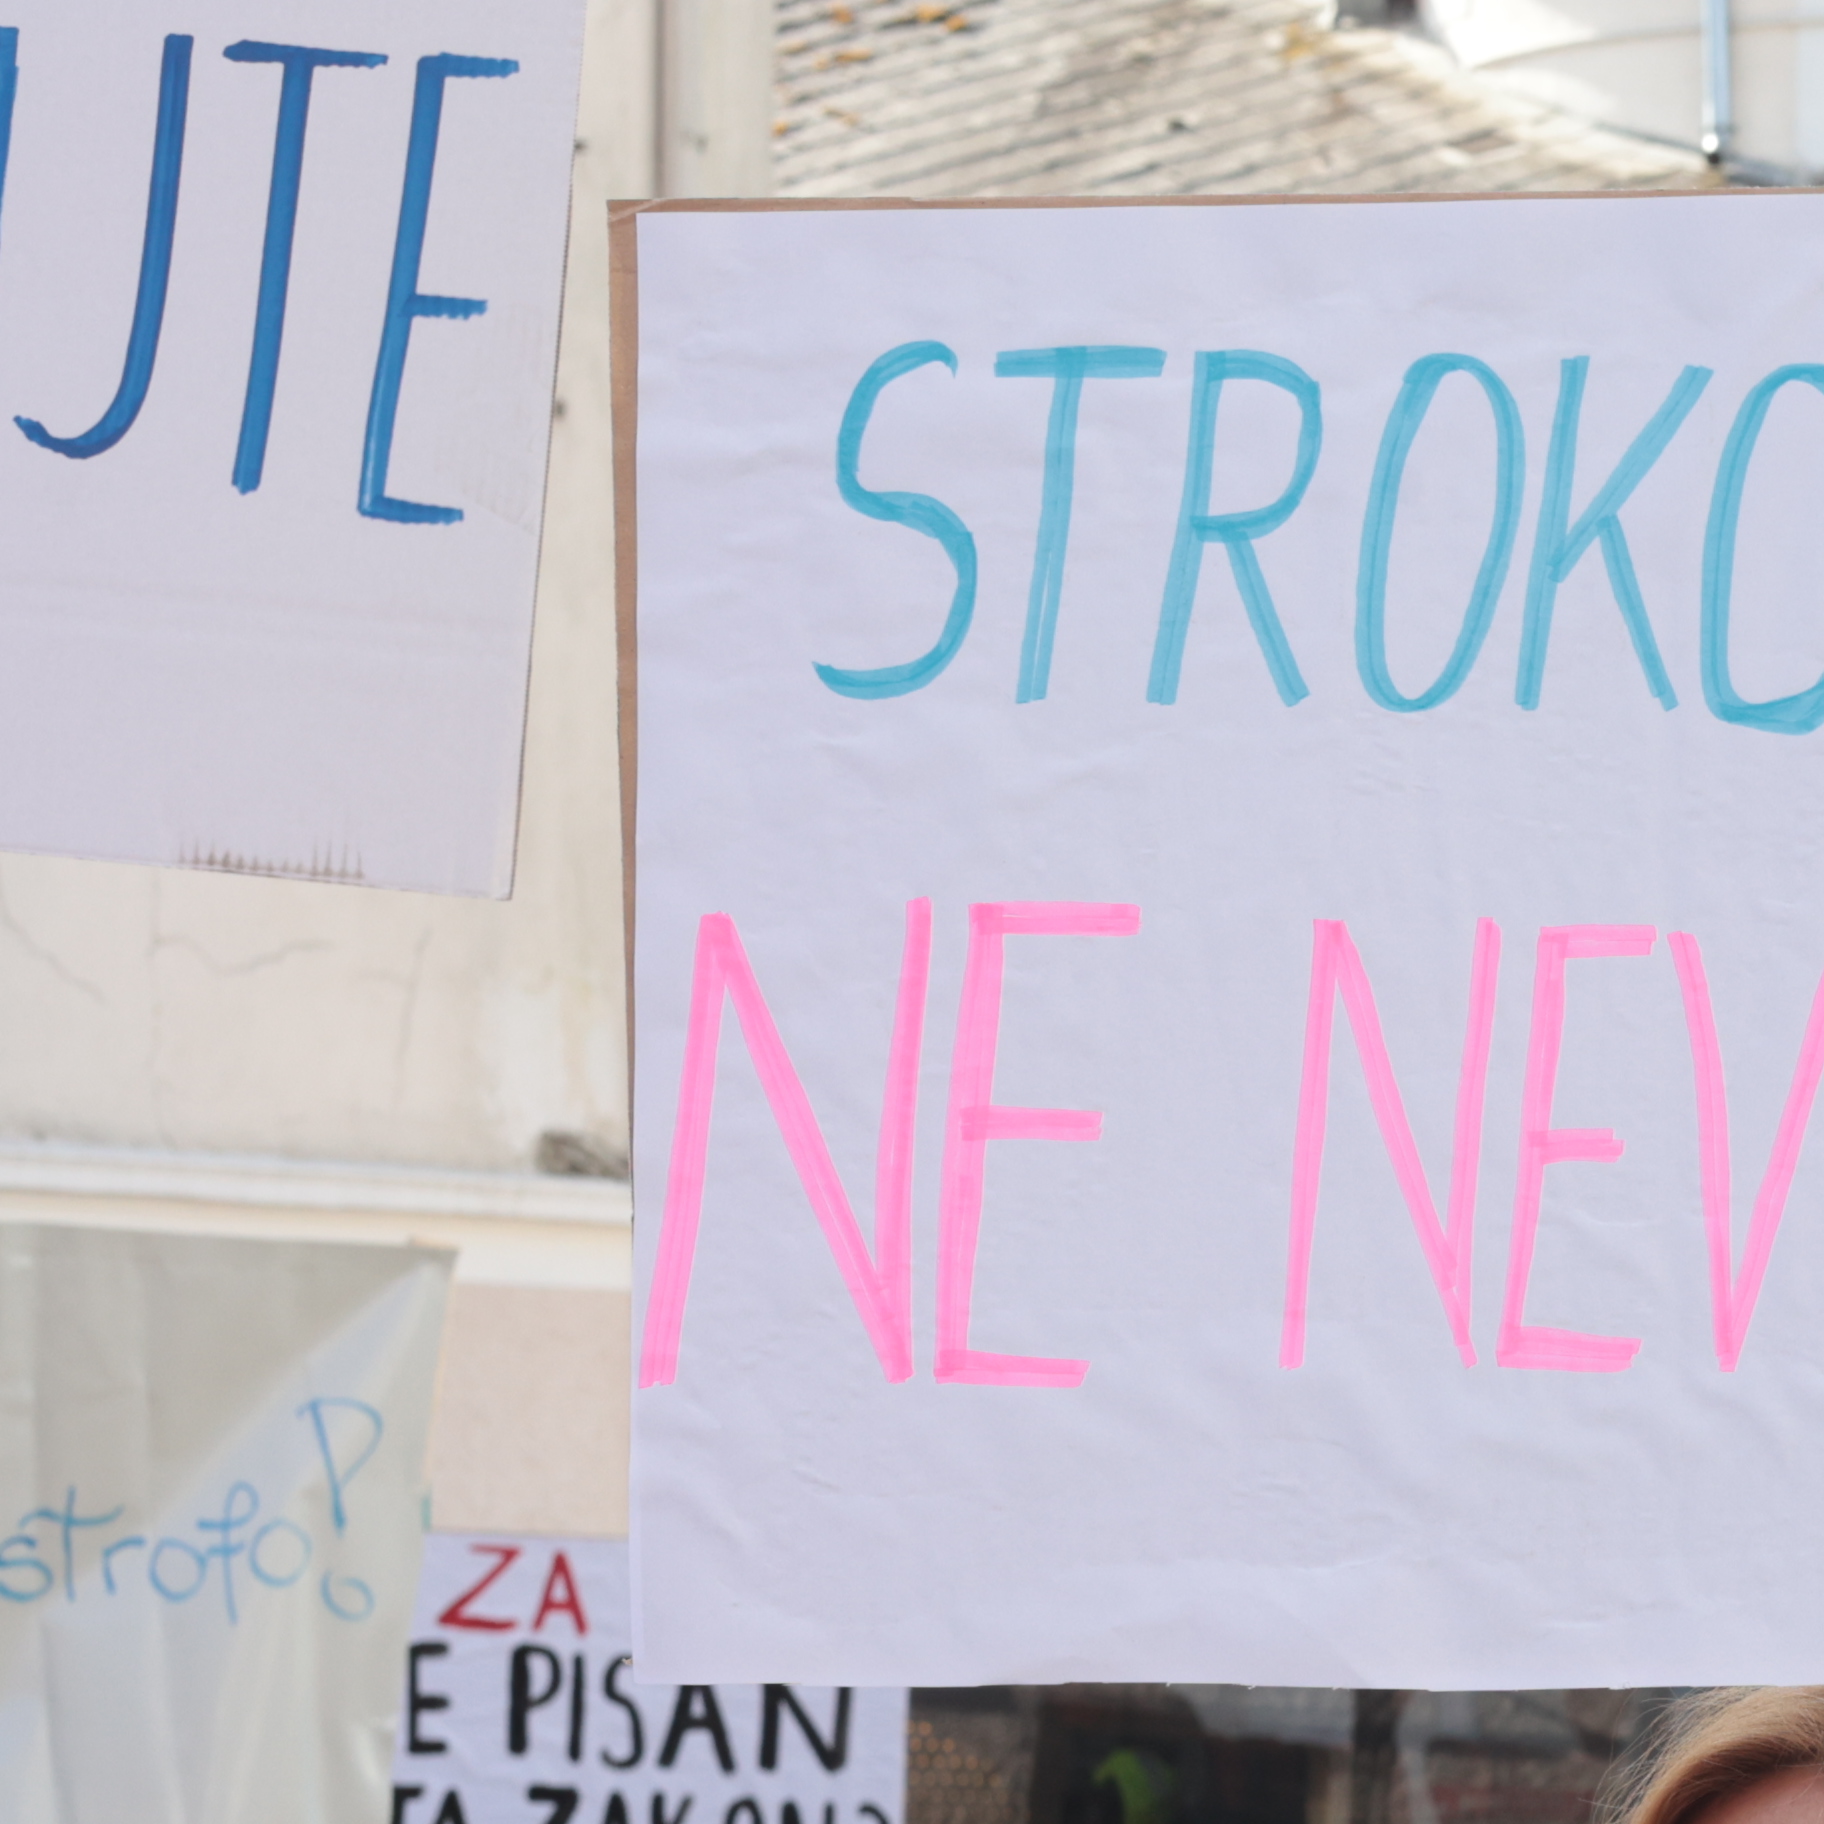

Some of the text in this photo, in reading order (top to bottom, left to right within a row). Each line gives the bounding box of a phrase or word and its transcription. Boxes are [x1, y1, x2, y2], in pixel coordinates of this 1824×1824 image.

[638, 896, 1142, 1390] NE
[436, 1543, 589, 1637] ZA
[507, 1644, 855, 1774] PISAN
